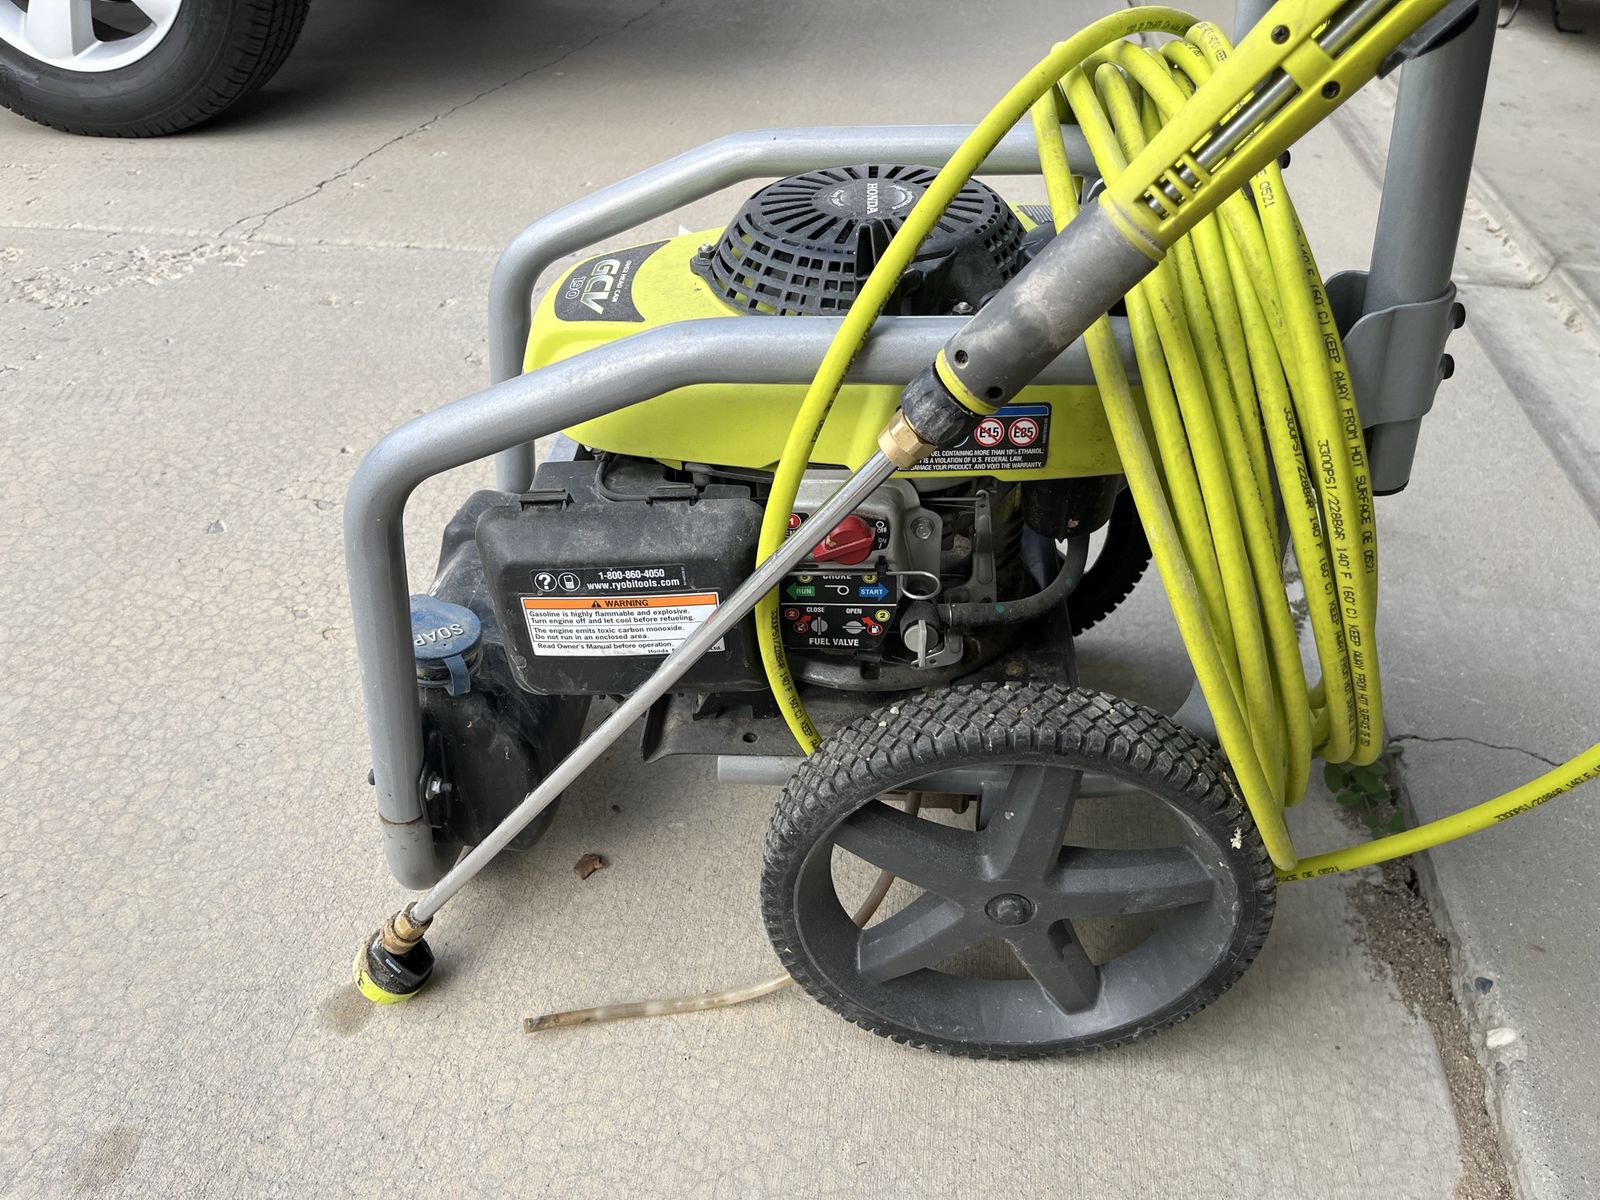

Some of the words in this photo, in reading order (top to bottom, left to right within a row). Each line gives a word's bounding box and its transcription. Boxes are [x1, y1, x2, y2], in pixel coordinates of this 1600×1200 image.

[867, 183, 878, 215] HONDA
[1260, 181, 1275, 209] 0521
[565, 276, 586, 299] 190
[580, 259, 621, 315] GCV
[1323, 333, 1341, 364] KEEP
[1333, 370, 1351, 401] AWAY
[979, 427, 999, 438] E15
[1013, 426, 1034, 438] E85
[1343, 408, 1359, 440] FROM
[1350, 445, 1364, 468] HOT
[1318, 439, 1346, 541] 3300PSI/228BAR
[1355, 475, 1371, 525] SURFACE
[587, 578, 680, 590] www.ryobitools.com
[598, 568, 665, 580] 1-800-860-4050
[571, 611, 593, 619] highly
[653, 608, 690, 616] explosive.
[605, 599, 649, 607] WARNING
[1328, 600, 1340, 625] KEEP
[660, 615, 695, 623] refueling.
[414, 623, 464, 646] SOAP
[638, 641, 674, 650] operation.
[809, 638, 831, 646] FUEL
[832, 638, 860, 647] VALVE
[1349, 624, 1361, 647] KEEP
[1352, 649, 1365, 671] AWAY
